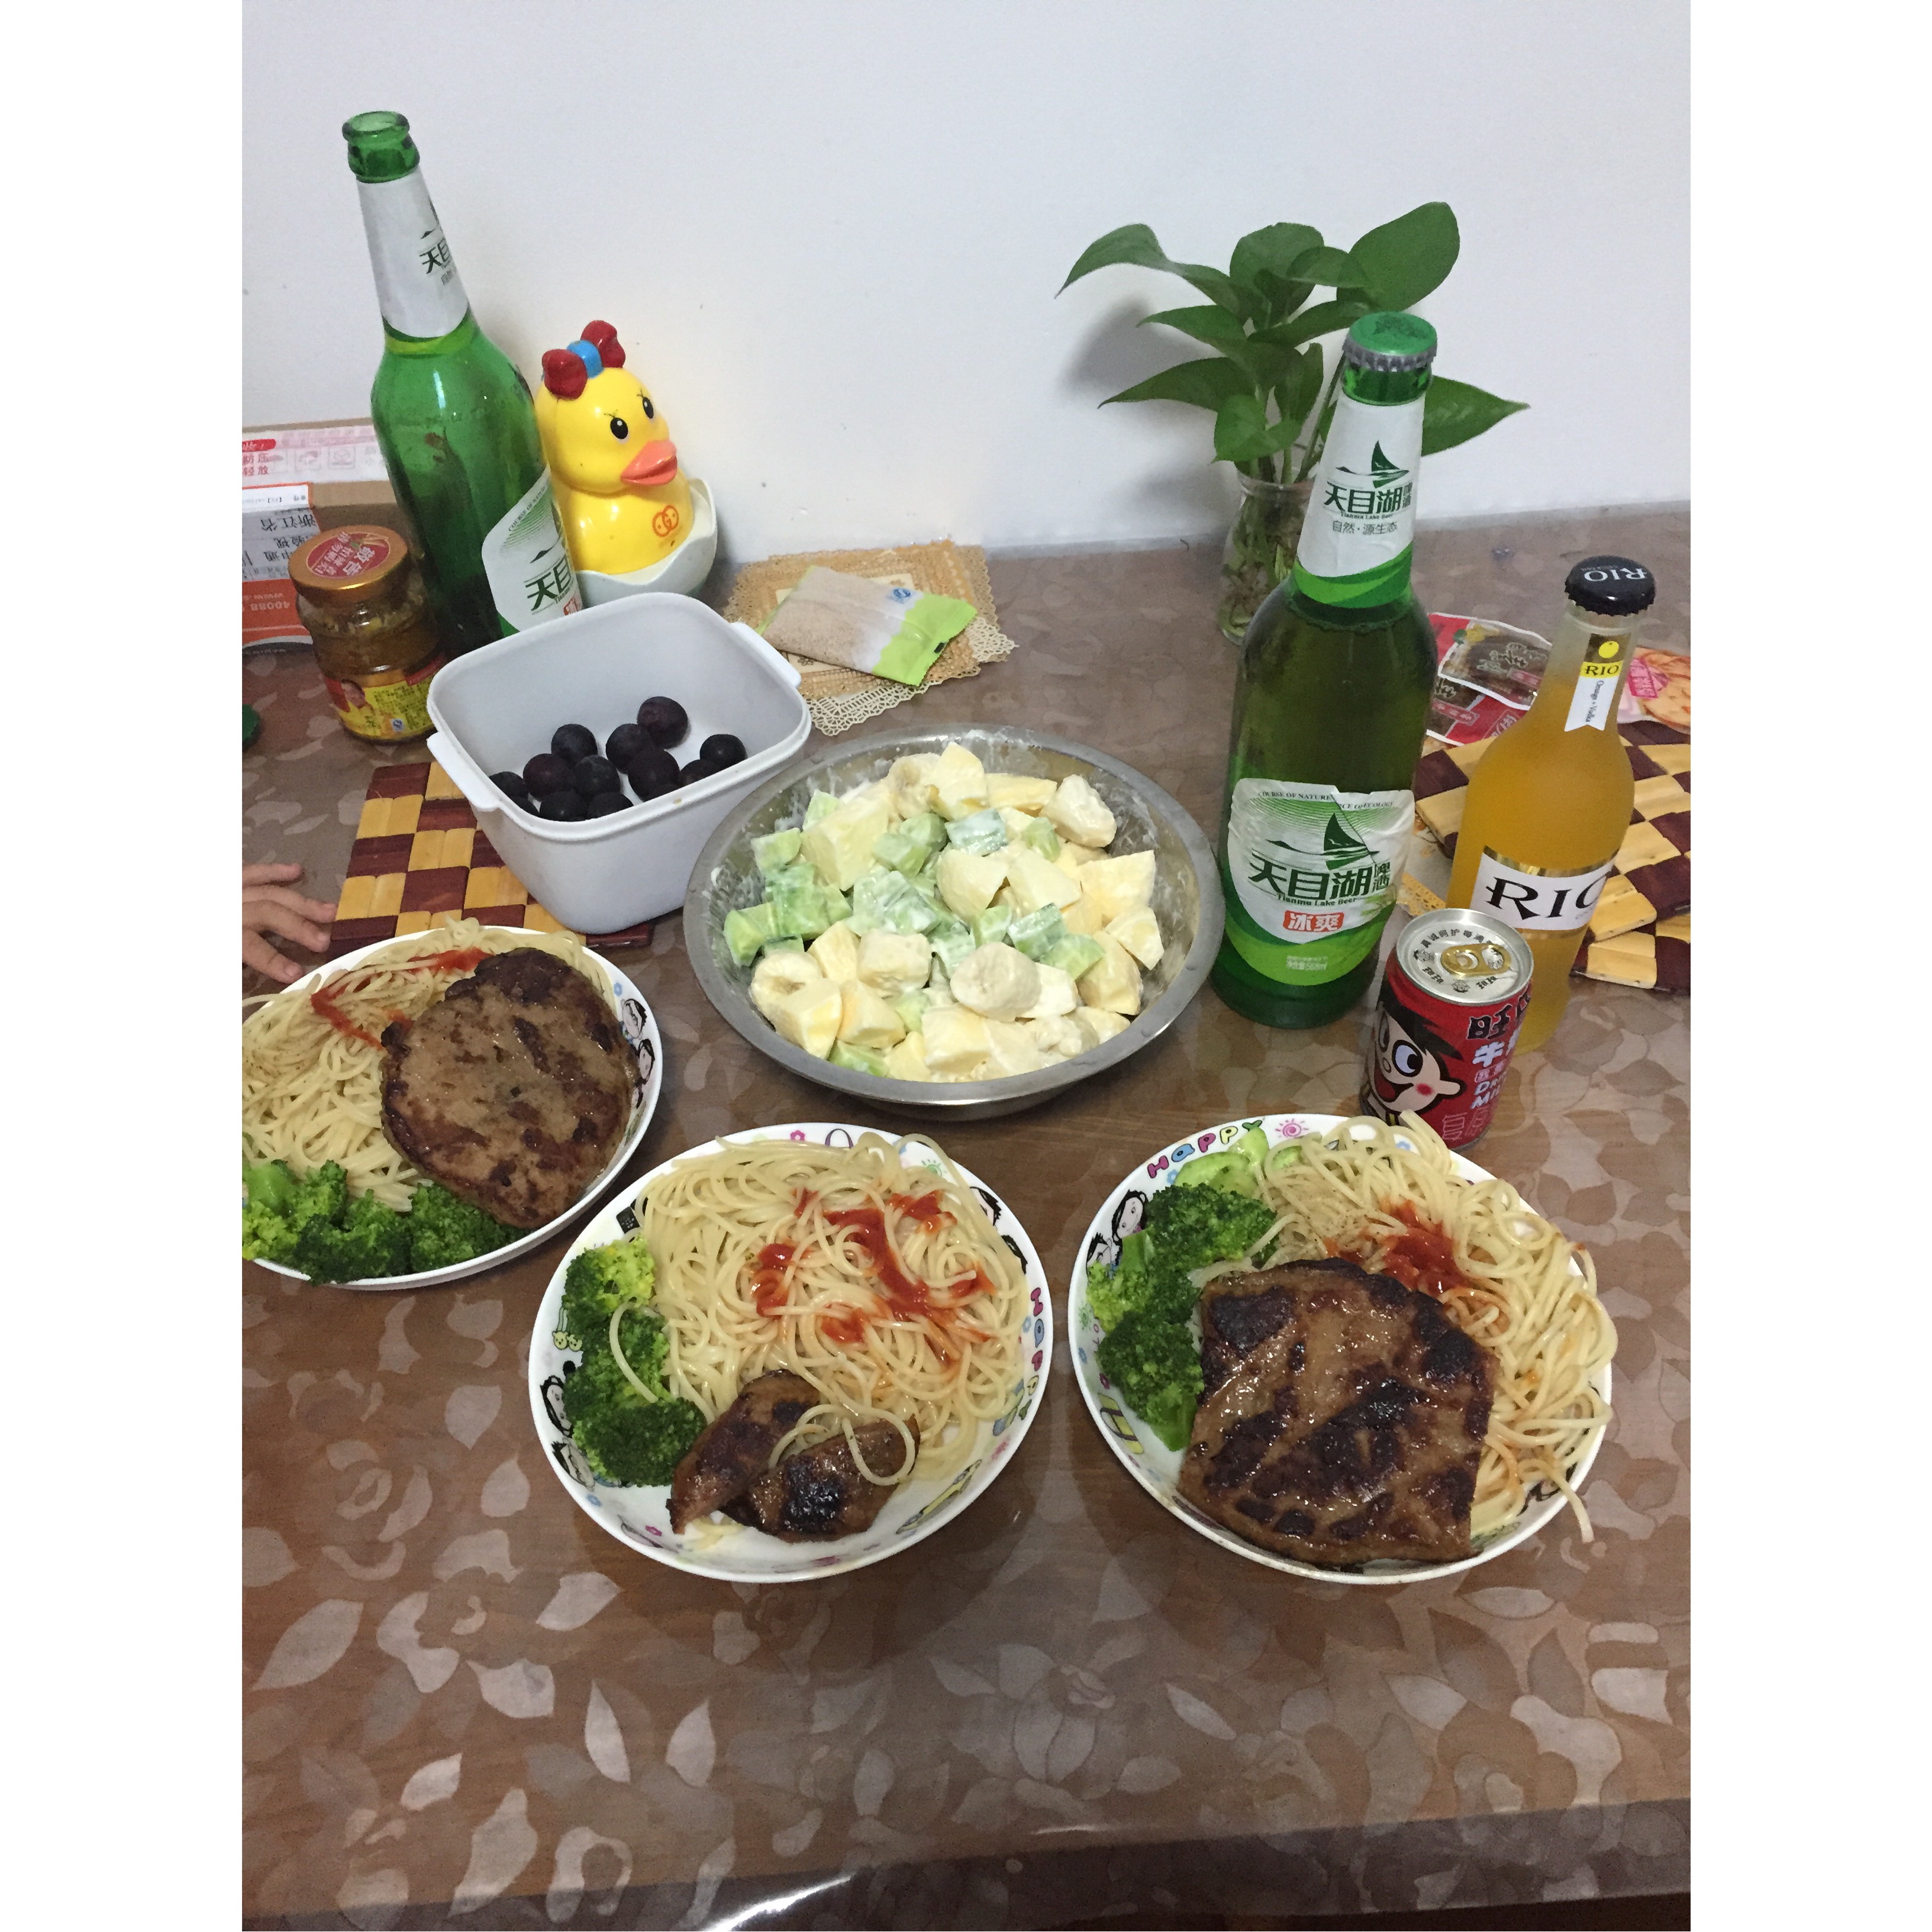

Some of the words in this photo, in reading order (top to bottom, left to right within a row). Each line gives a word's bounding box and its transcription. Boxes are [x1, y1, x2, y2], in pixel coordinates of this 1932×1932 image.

[1324, 480, 1403, 514] 天目湖
[261, 514, 316, 532] 浙江省
[1584, 567, 1647, 582] RIO
[1585, 665, 1620, 676] RIO
[1248, 853, 1372, 900] 天目湖
[1288, 912, 1340, 931] 冰爽
